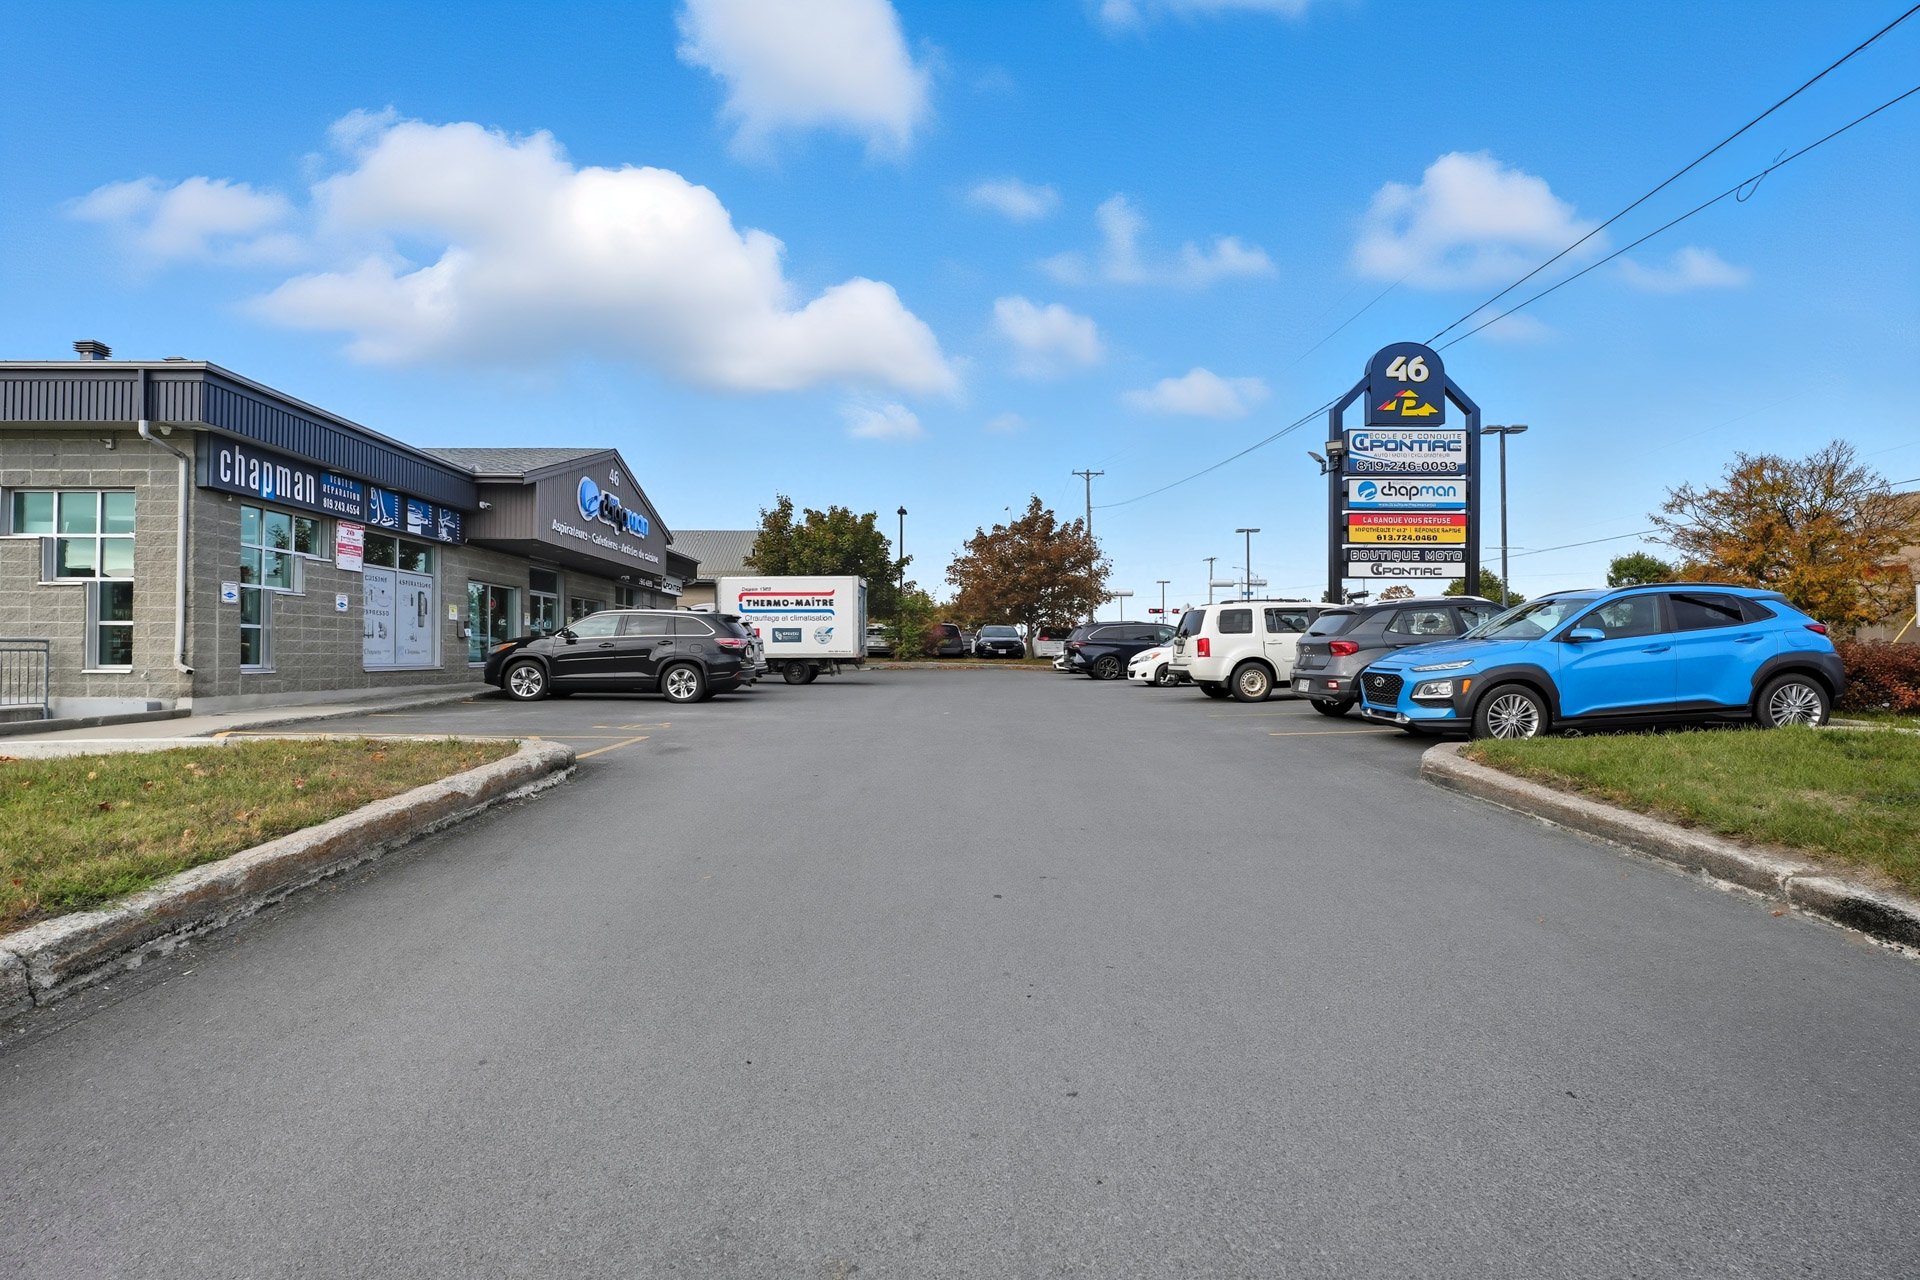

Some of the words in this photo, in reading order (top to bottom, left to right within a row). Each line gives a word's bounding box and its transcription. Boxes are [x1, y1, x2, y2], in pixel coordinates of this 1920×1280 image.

[1386, 355, 1429, 382] 46
[220, 445, 315, 504] chapman
[609, 469, 619, 486] 46
[1381, 482, 1456, 500] chapman
[552, 519, 588, 540] Aspirateurs
[1350, 550, 1420, 562] BOUTIQUE
[1425, 550, 1462, 561] MOTO
[746, 597, 834, 606] THERMO-MAÎTRE
